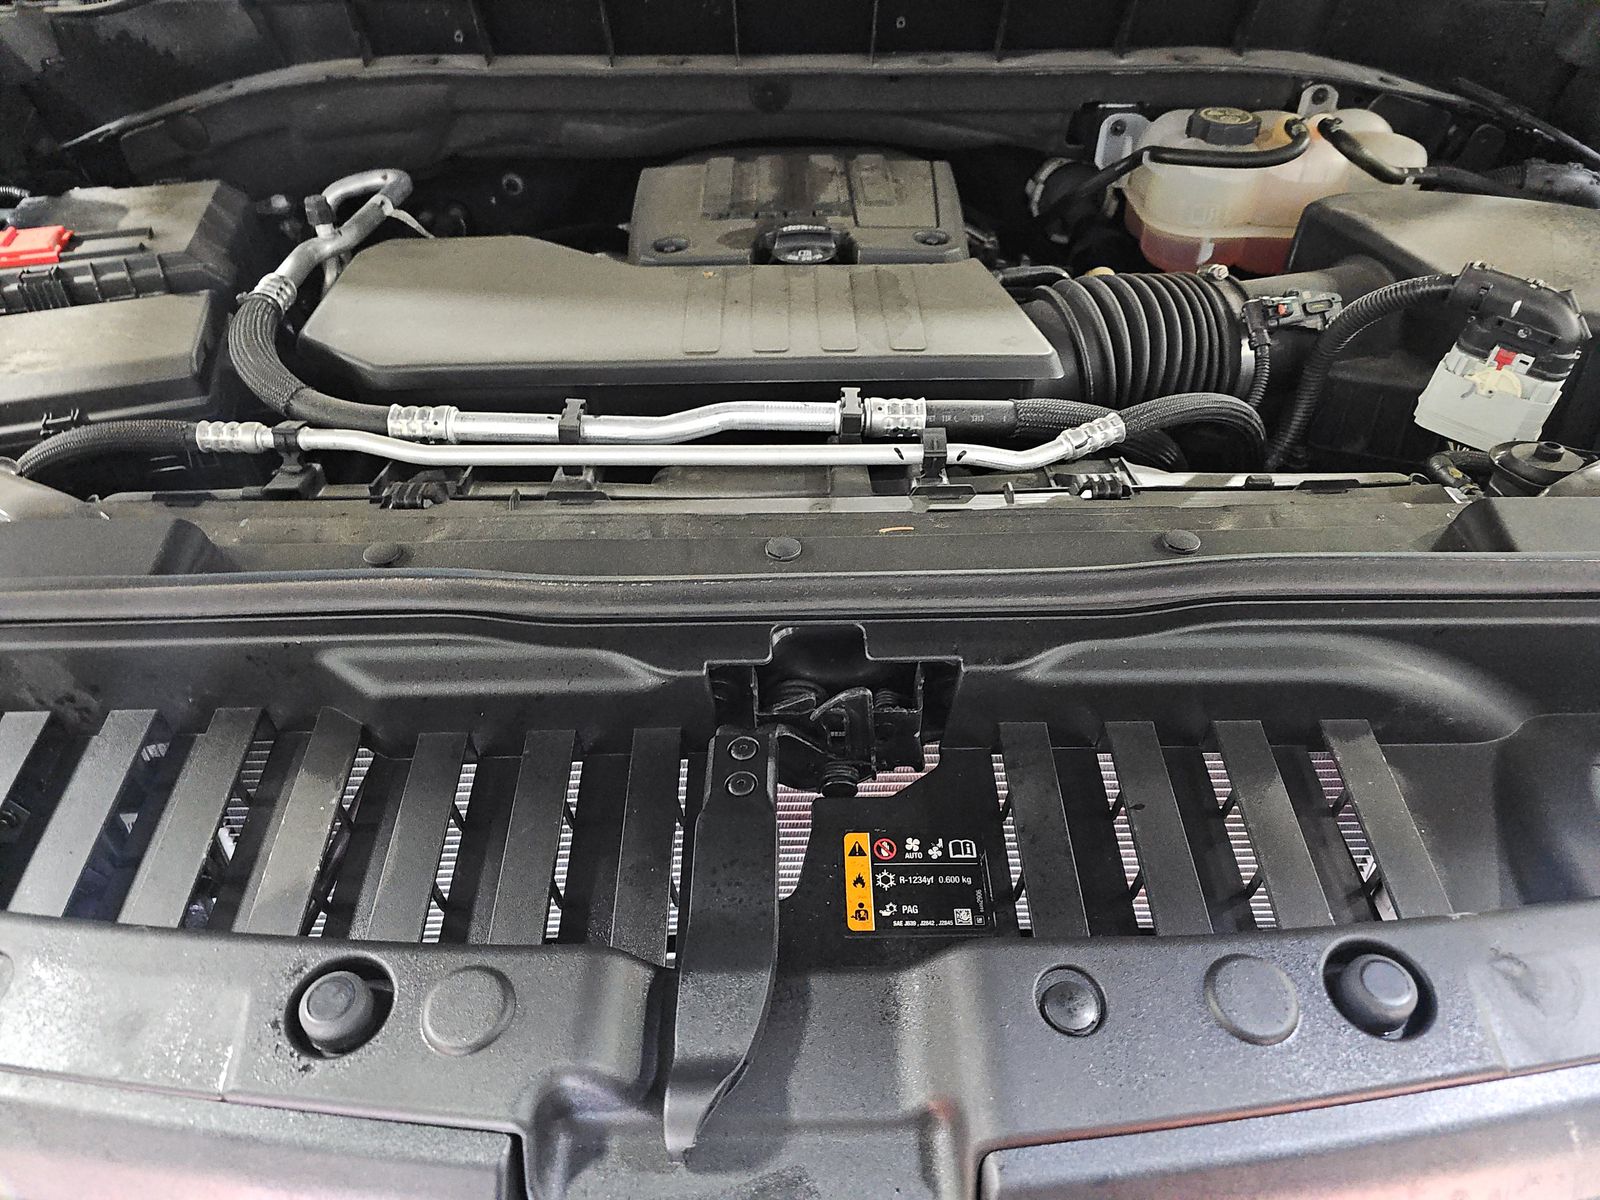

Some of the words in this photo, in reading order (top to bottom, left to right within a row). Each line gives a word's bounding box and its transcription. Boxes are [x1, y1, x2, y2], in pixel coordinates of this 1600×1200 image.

[899, 876, 934, 886] R-1234yf
[938, 876, 960, 884] 0.600
[962, 876, 972, 885] kg
[902, 905, 918, 914] PAG
